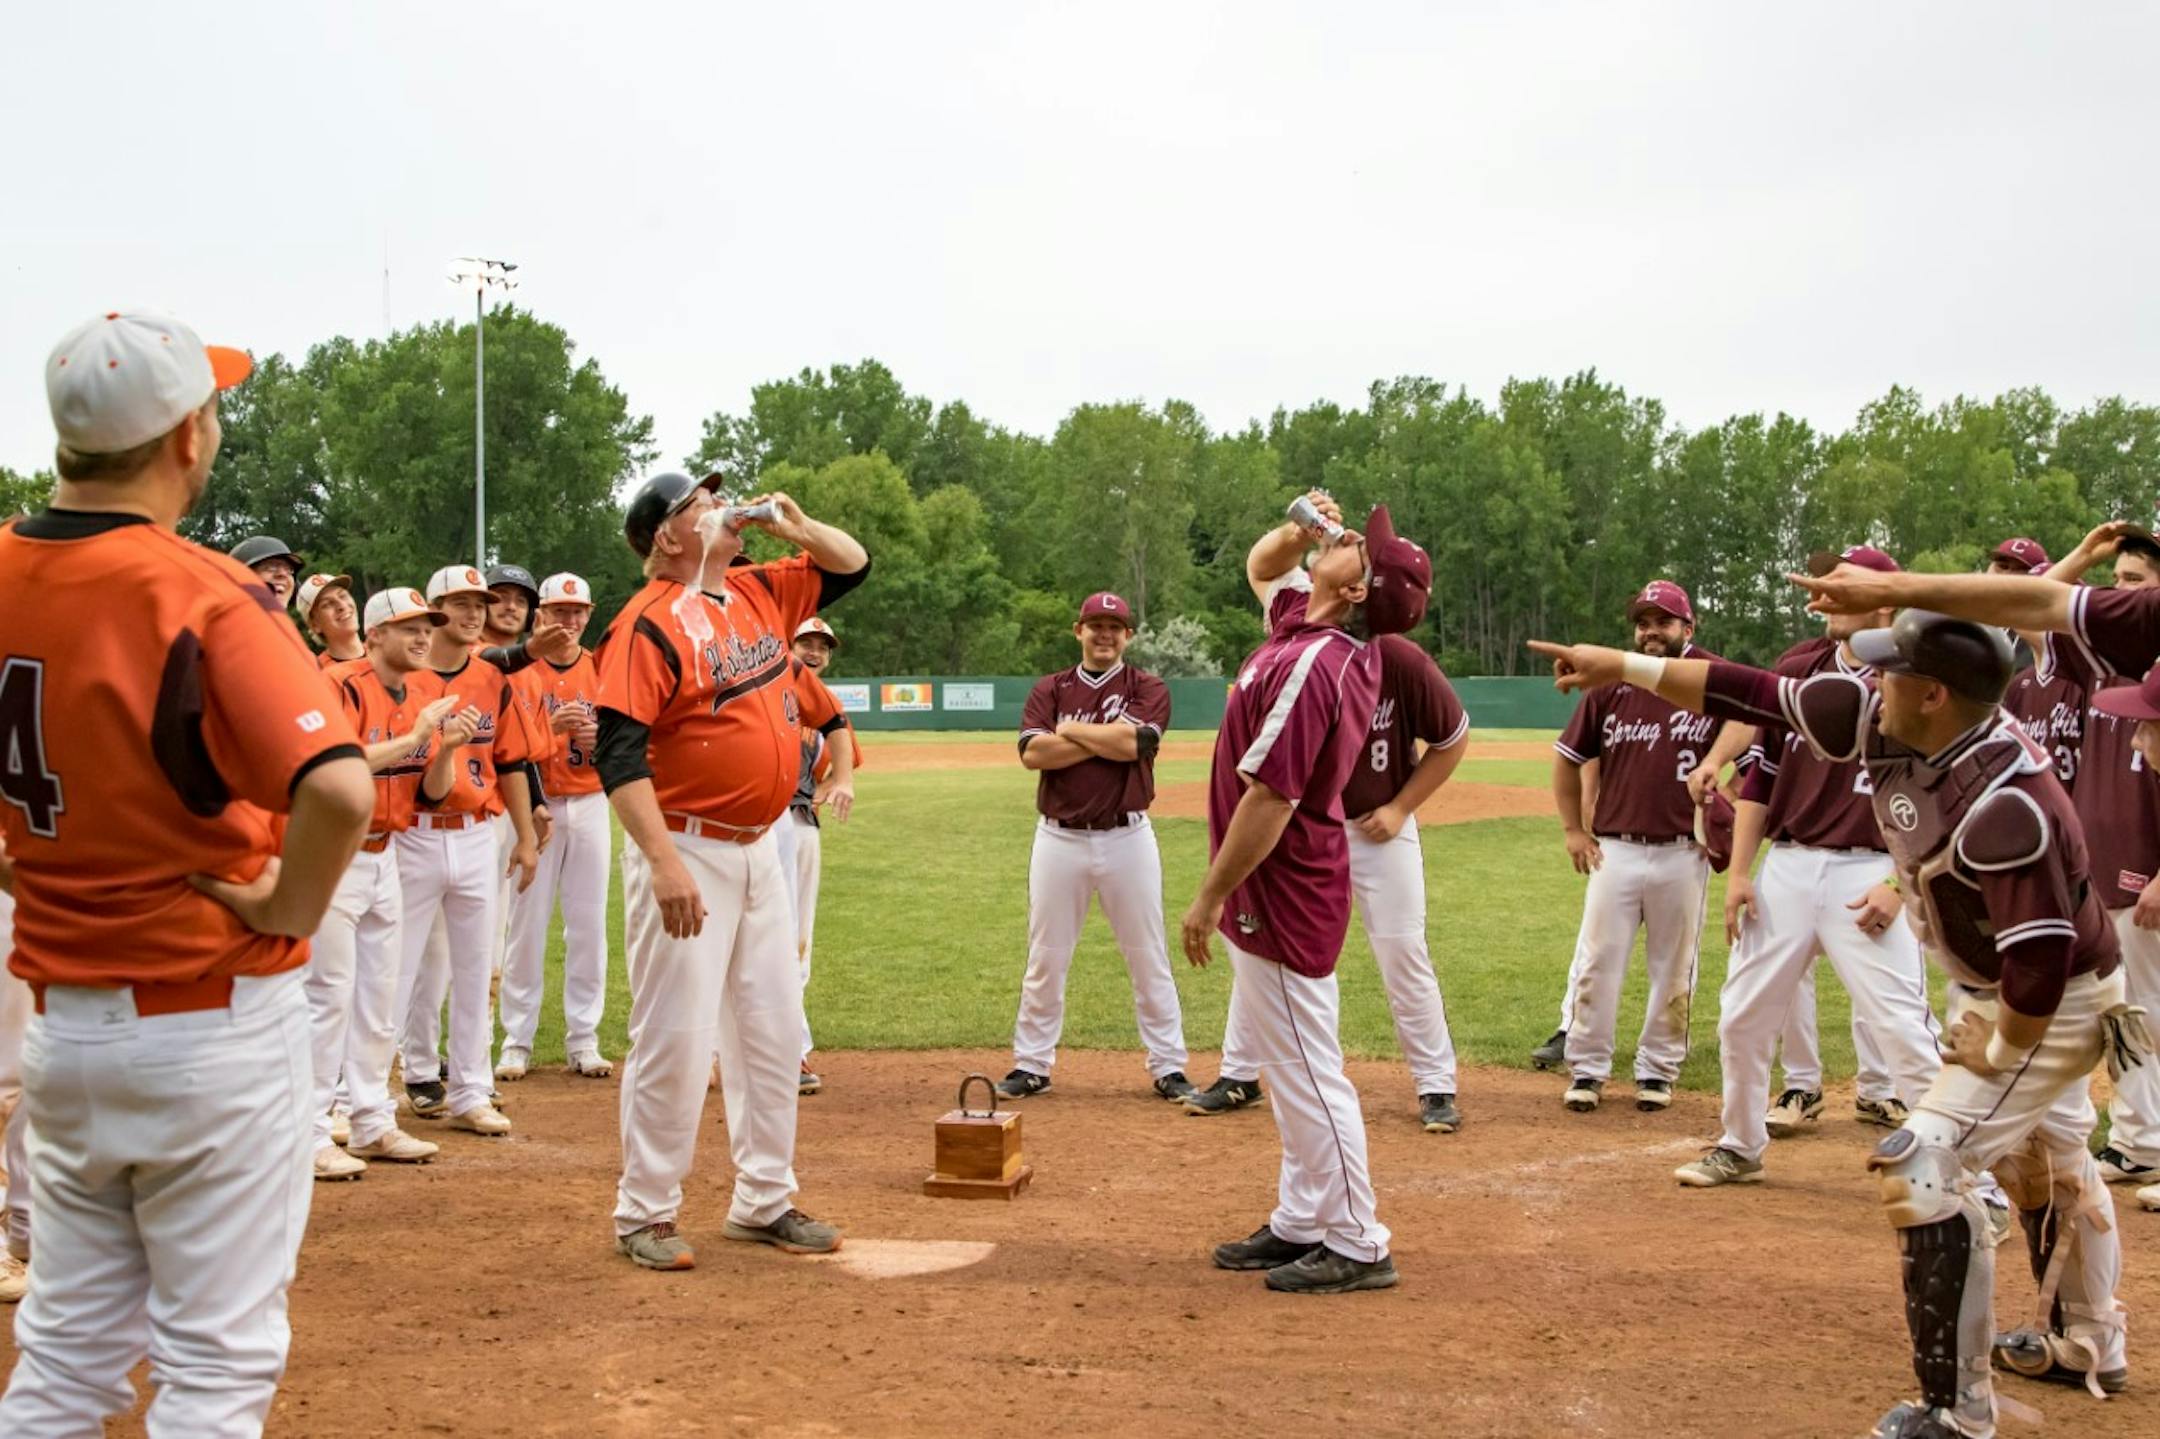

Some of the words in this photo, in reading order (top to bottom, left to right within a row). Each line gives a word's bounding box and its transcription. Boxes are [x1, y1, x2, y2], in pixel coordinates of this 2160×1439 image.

[2010, 540, 2029, 555] C
[1102, 594, 1117, 610] C
[1646, 581, 1661, 601] C
[1371, 697, 1395, 731] ill
[1603, 713, 1662, 752] Spring
[1669, 710, 1714, 743] Hill
[0, 657, 64, 838] 4
[1371, 739, 1388, 772] 8
[1675, 750, 1697, 782] 2
